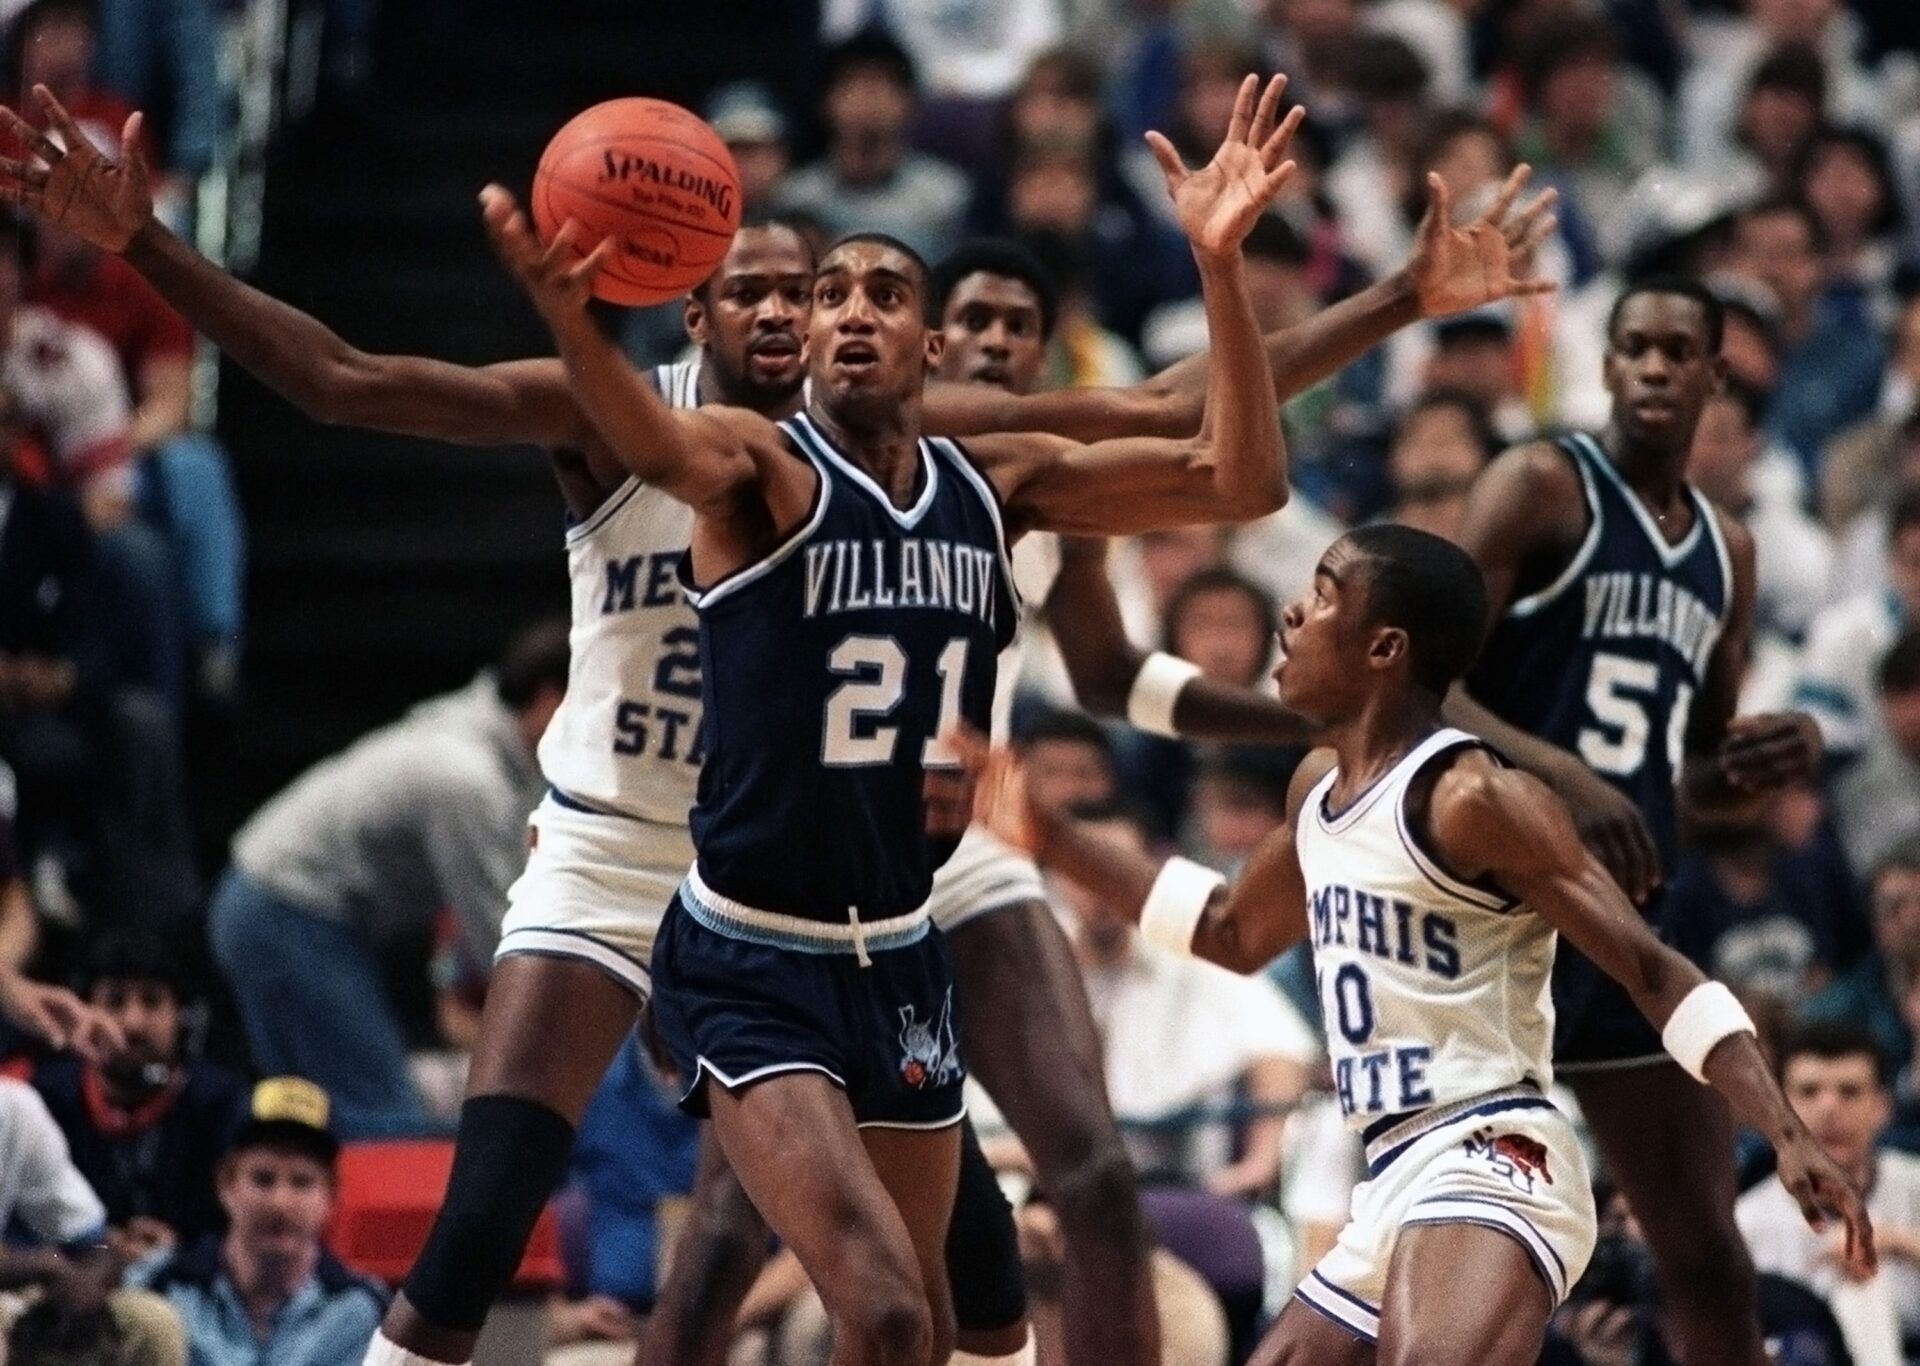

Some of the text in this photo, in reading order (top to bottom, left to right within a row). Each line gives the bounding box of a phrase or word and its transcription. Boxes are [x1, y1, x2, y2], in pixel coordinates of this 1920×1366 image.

[599, 149, 732, 220] SPALDING
[602, 550, 690, 615] ME
[803, 538, 996, 631] VILLANOV
[820, 632, 972, 769] 21
[1308, 885, 1461, 980] MPHIS
[1317, 963, 1375, 1045] 0
